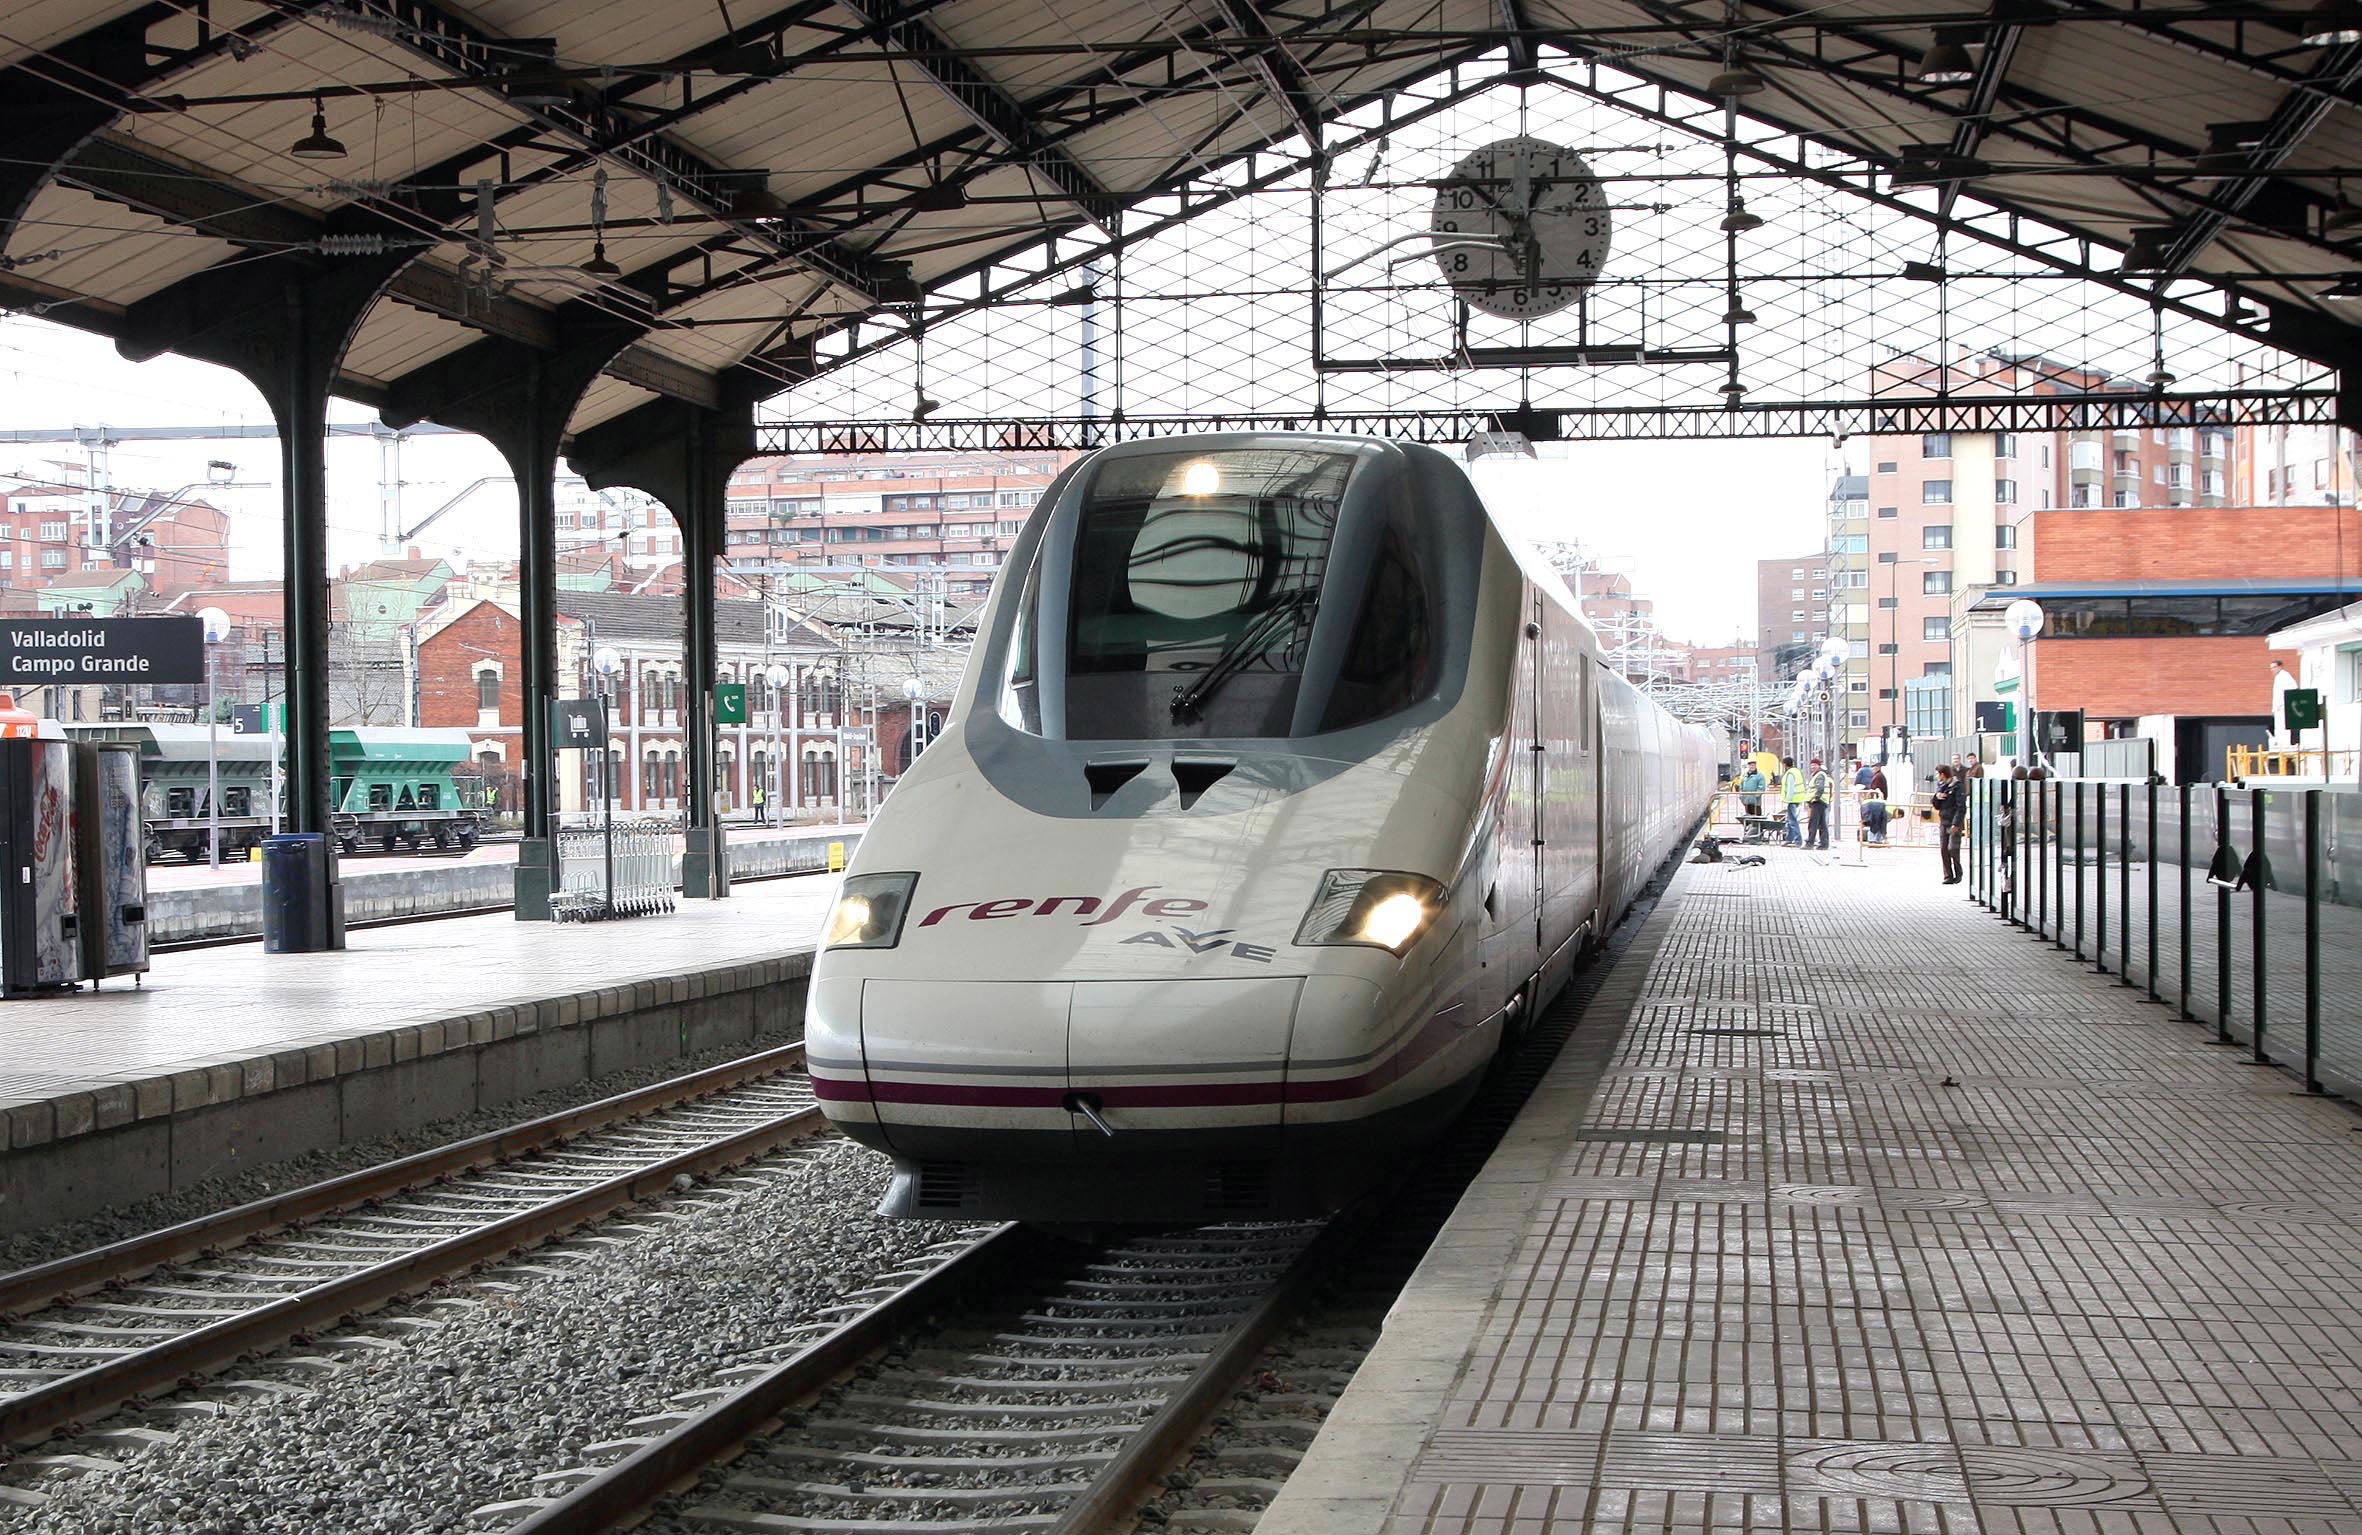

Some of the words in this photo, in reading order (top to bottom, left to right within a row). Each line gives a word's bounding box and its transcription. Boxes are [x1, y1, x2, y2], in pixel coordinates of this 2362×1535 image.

[1477, 161, 1495, 178] 11
[1550, 160, 1560, 177] 1
[1450, 190, 1474, 209] 10
[1575, 184, 1589, 203] 2
[1584, 218, 1599, 236] 3
[1454, 253, 1468, 272] 8
[1577, 250, 1592, 267] 4
[1513, 287, 1528, 305] 6
[11, 629, 105, 647] Valladolid
[12, 655, 76, 675] Campo
[81, 655, 150, 672] Grande
[235, 718, 244, 733] 5
[1976, 716, 1986, 732] 1
[918, 885, 1209, 928] renfe
[1118, 925, 1278, 964] AVE
